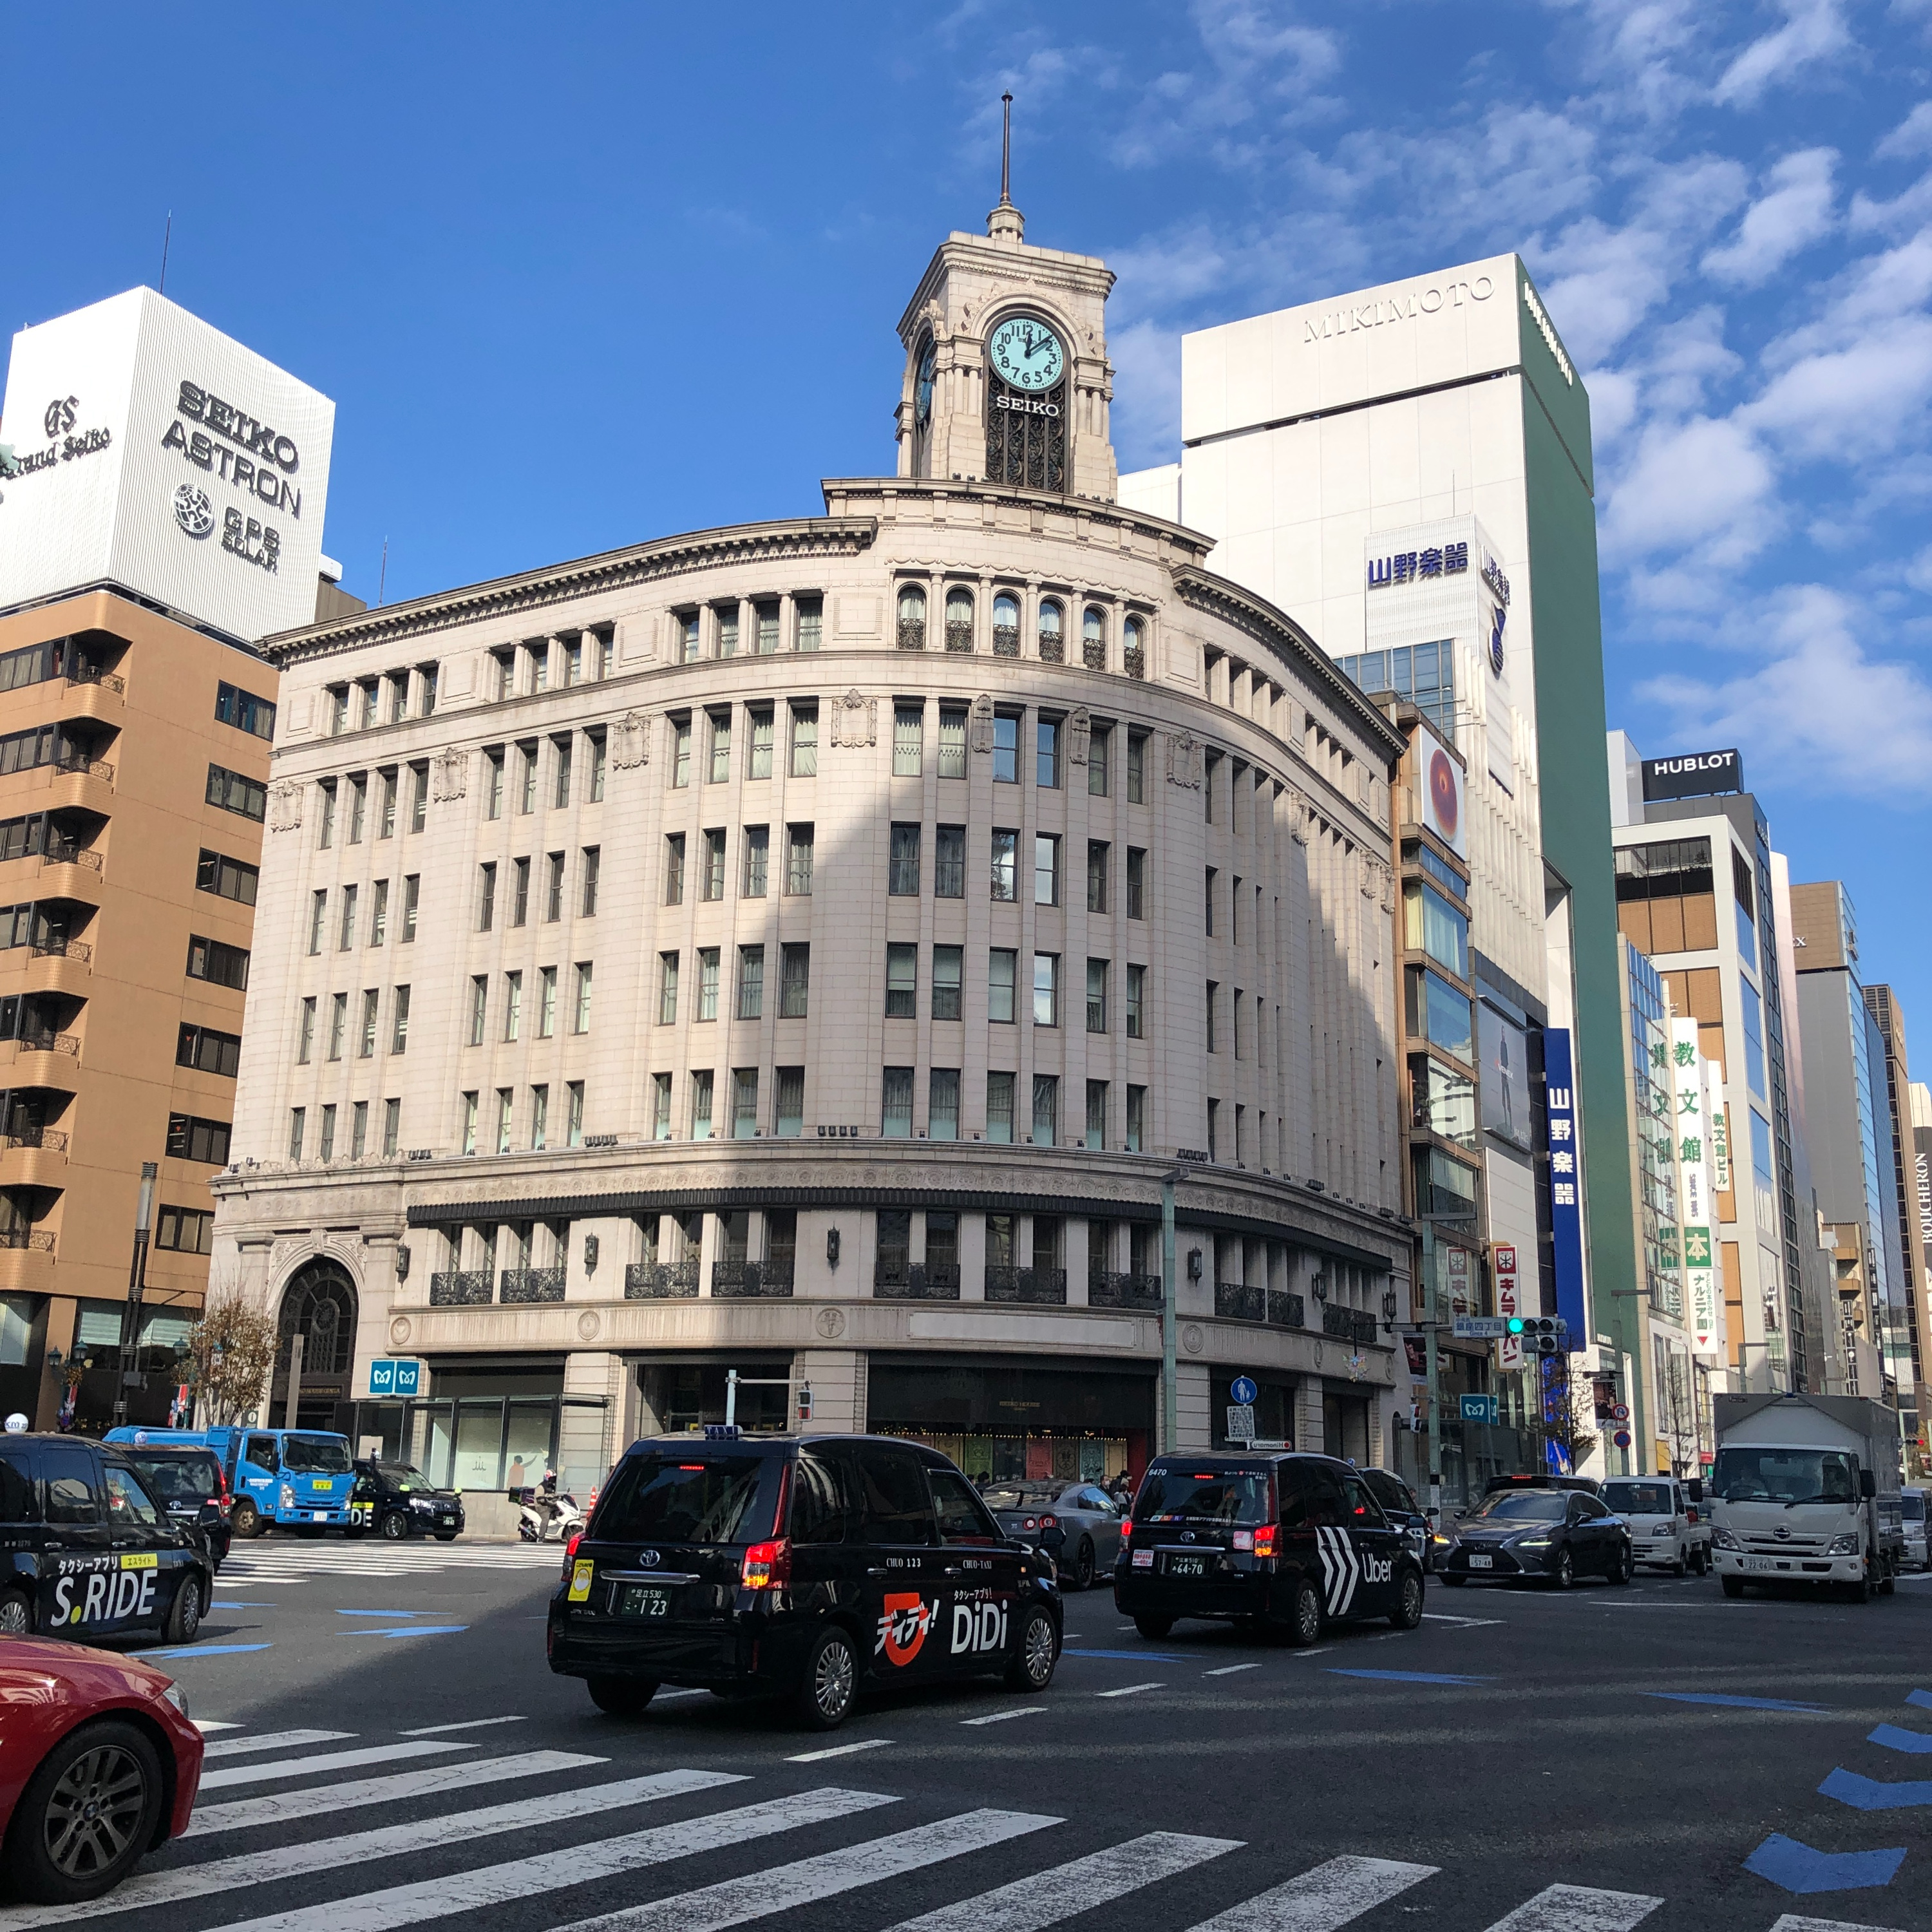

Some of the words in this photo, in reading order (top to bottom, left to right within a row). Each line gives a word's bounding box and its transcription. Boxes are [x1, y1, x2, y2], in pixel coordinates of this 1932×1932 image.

[1304, 276, 1495, 343] MIKIMOTO
[1001, 332, 1011, 345] 10
[1012, 325, 1019, 337] 11
[1038, 330, 1041, 341] 1
[997, 344, 1005, 355] 9
[1048, 353, 1057, 365] 3
[1001, 356, 1010, 368] 8
[1011, 366, 1020, 378] 7
[1043, 365, 1053, 376] 4
[1022, 372, 1030, 384] 6
[1034, 371, 1043, 383] 5
[44, 395, 79, 438] GS
[996, 395, 1059, 417] SEIKO
[178, 380, 299, 472] SEIKO
[61, 427, 111, 461] Seiko
[162, 420, 301, 517] ASTRON
[224, 506, 279, 555] GPS
[222, 532, 278, 574] SOLAR
[1368, 542, 1468, 586] 山野楽器
[1654, 752, 1734, 775] HUBLOT
[1674, 1041, 1701, 1164] 教文館
[1549, 1088, 1575, 1205] 山野楽器
[1712, 1113, 1728, 1185] 教文館ビル
[1915, 1153, 1932, 1244] BOUCHERON
[1686, 1233, 1709, 1261] 本
[1694, 1274, 1707, 1330] ナルニア国
[1456, 1322, 1502, 1331] 銀座四丁目
[59, 1556, 117, 1575] タクシーアプリ
[128, 1557, 151, 1566] エスライド
[886, 1557, 903, 1567] CHUO
[907, 1558, 921, 1567] 123
[1177, 1564, 1203, 1575] 64-70
[1362, 1553, 1392, 1583] Uber
[636, 1589, 649, 1598] 足立
[649, 1589, 662, 1598] 530
[951, 1599, 1007, 1654] DiDi
